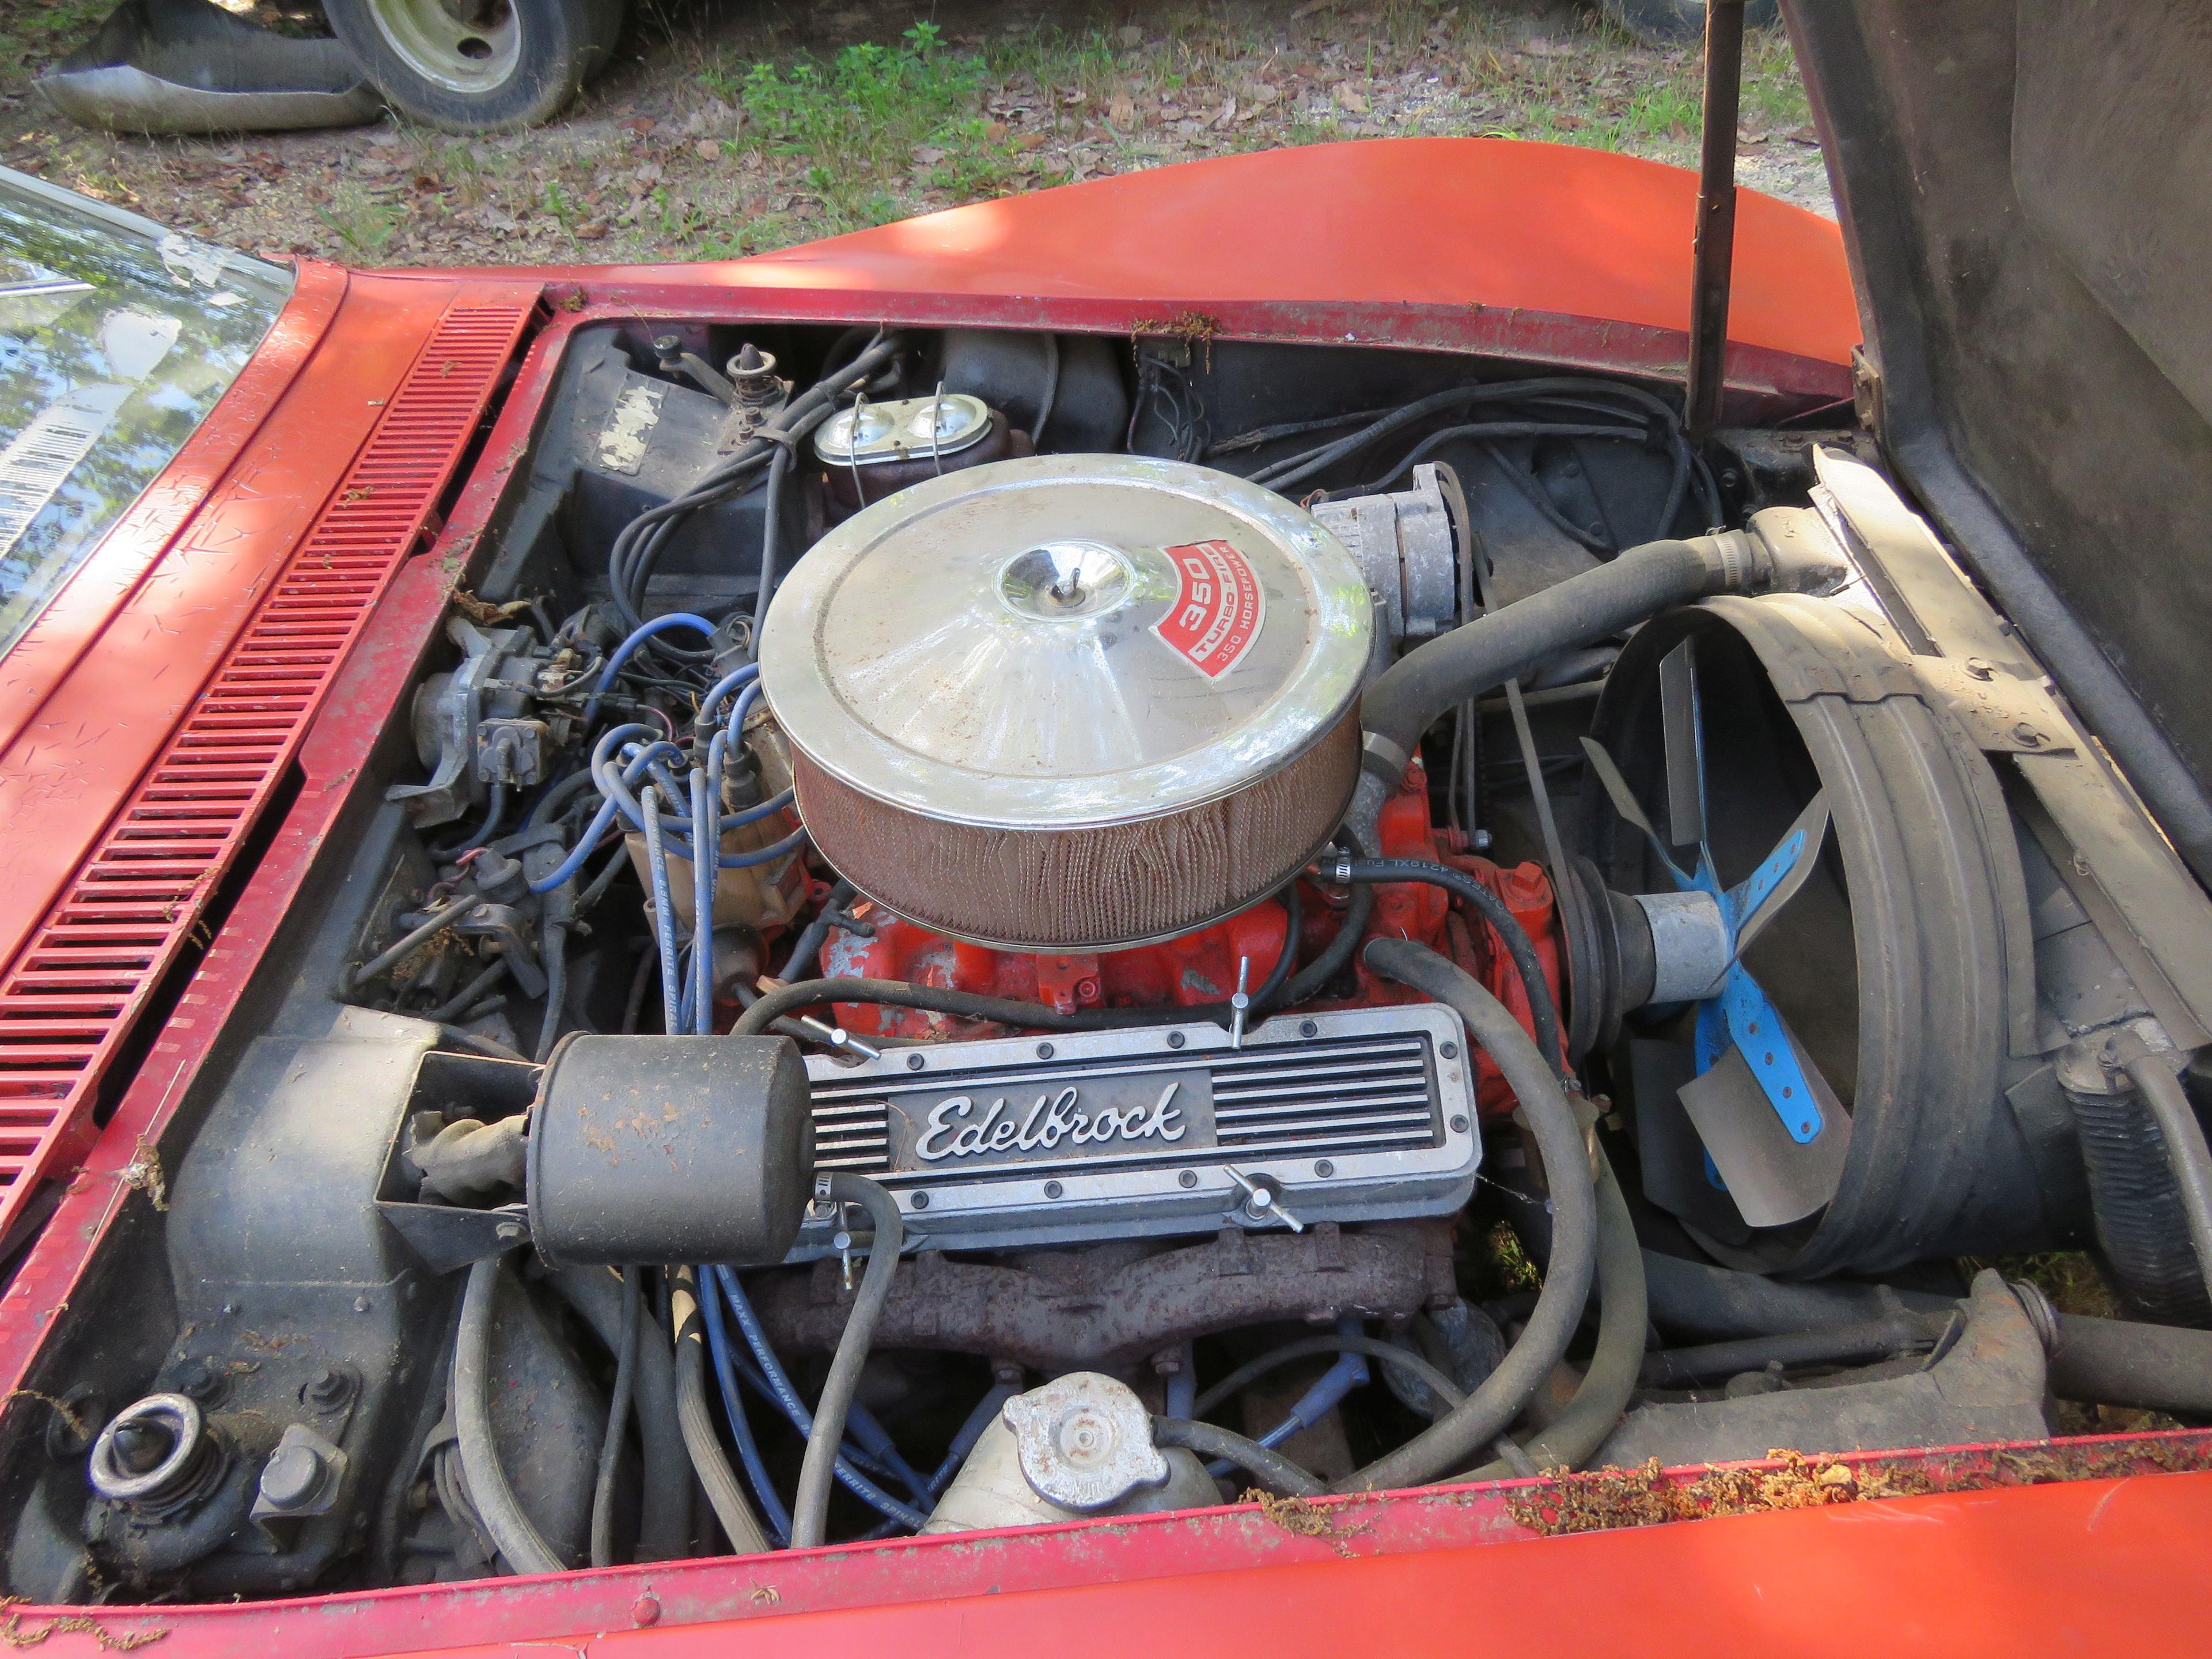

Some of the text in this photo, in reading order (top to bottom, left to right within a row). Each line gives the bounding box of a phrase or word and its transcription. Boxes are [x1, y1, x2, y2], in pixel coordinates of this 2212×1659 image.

[1179, 558, 1211, 631] 350
[1195, 546, 1235, 653] TURBO-FIRE
[1217, 546, 1253, 662] 350 HORSEPOWER
[1389, 859, 1449, 873] 4219XL
[662, 925, 676, 975] FERRITE
[668, 984, 678, 1028] SPIRAL
[915, 1081, 1186, 1161] Edelbrock
[730, 1294, 750, 1327] MAXX
[748, 1334, 801, 1418] PERFORMANCE
